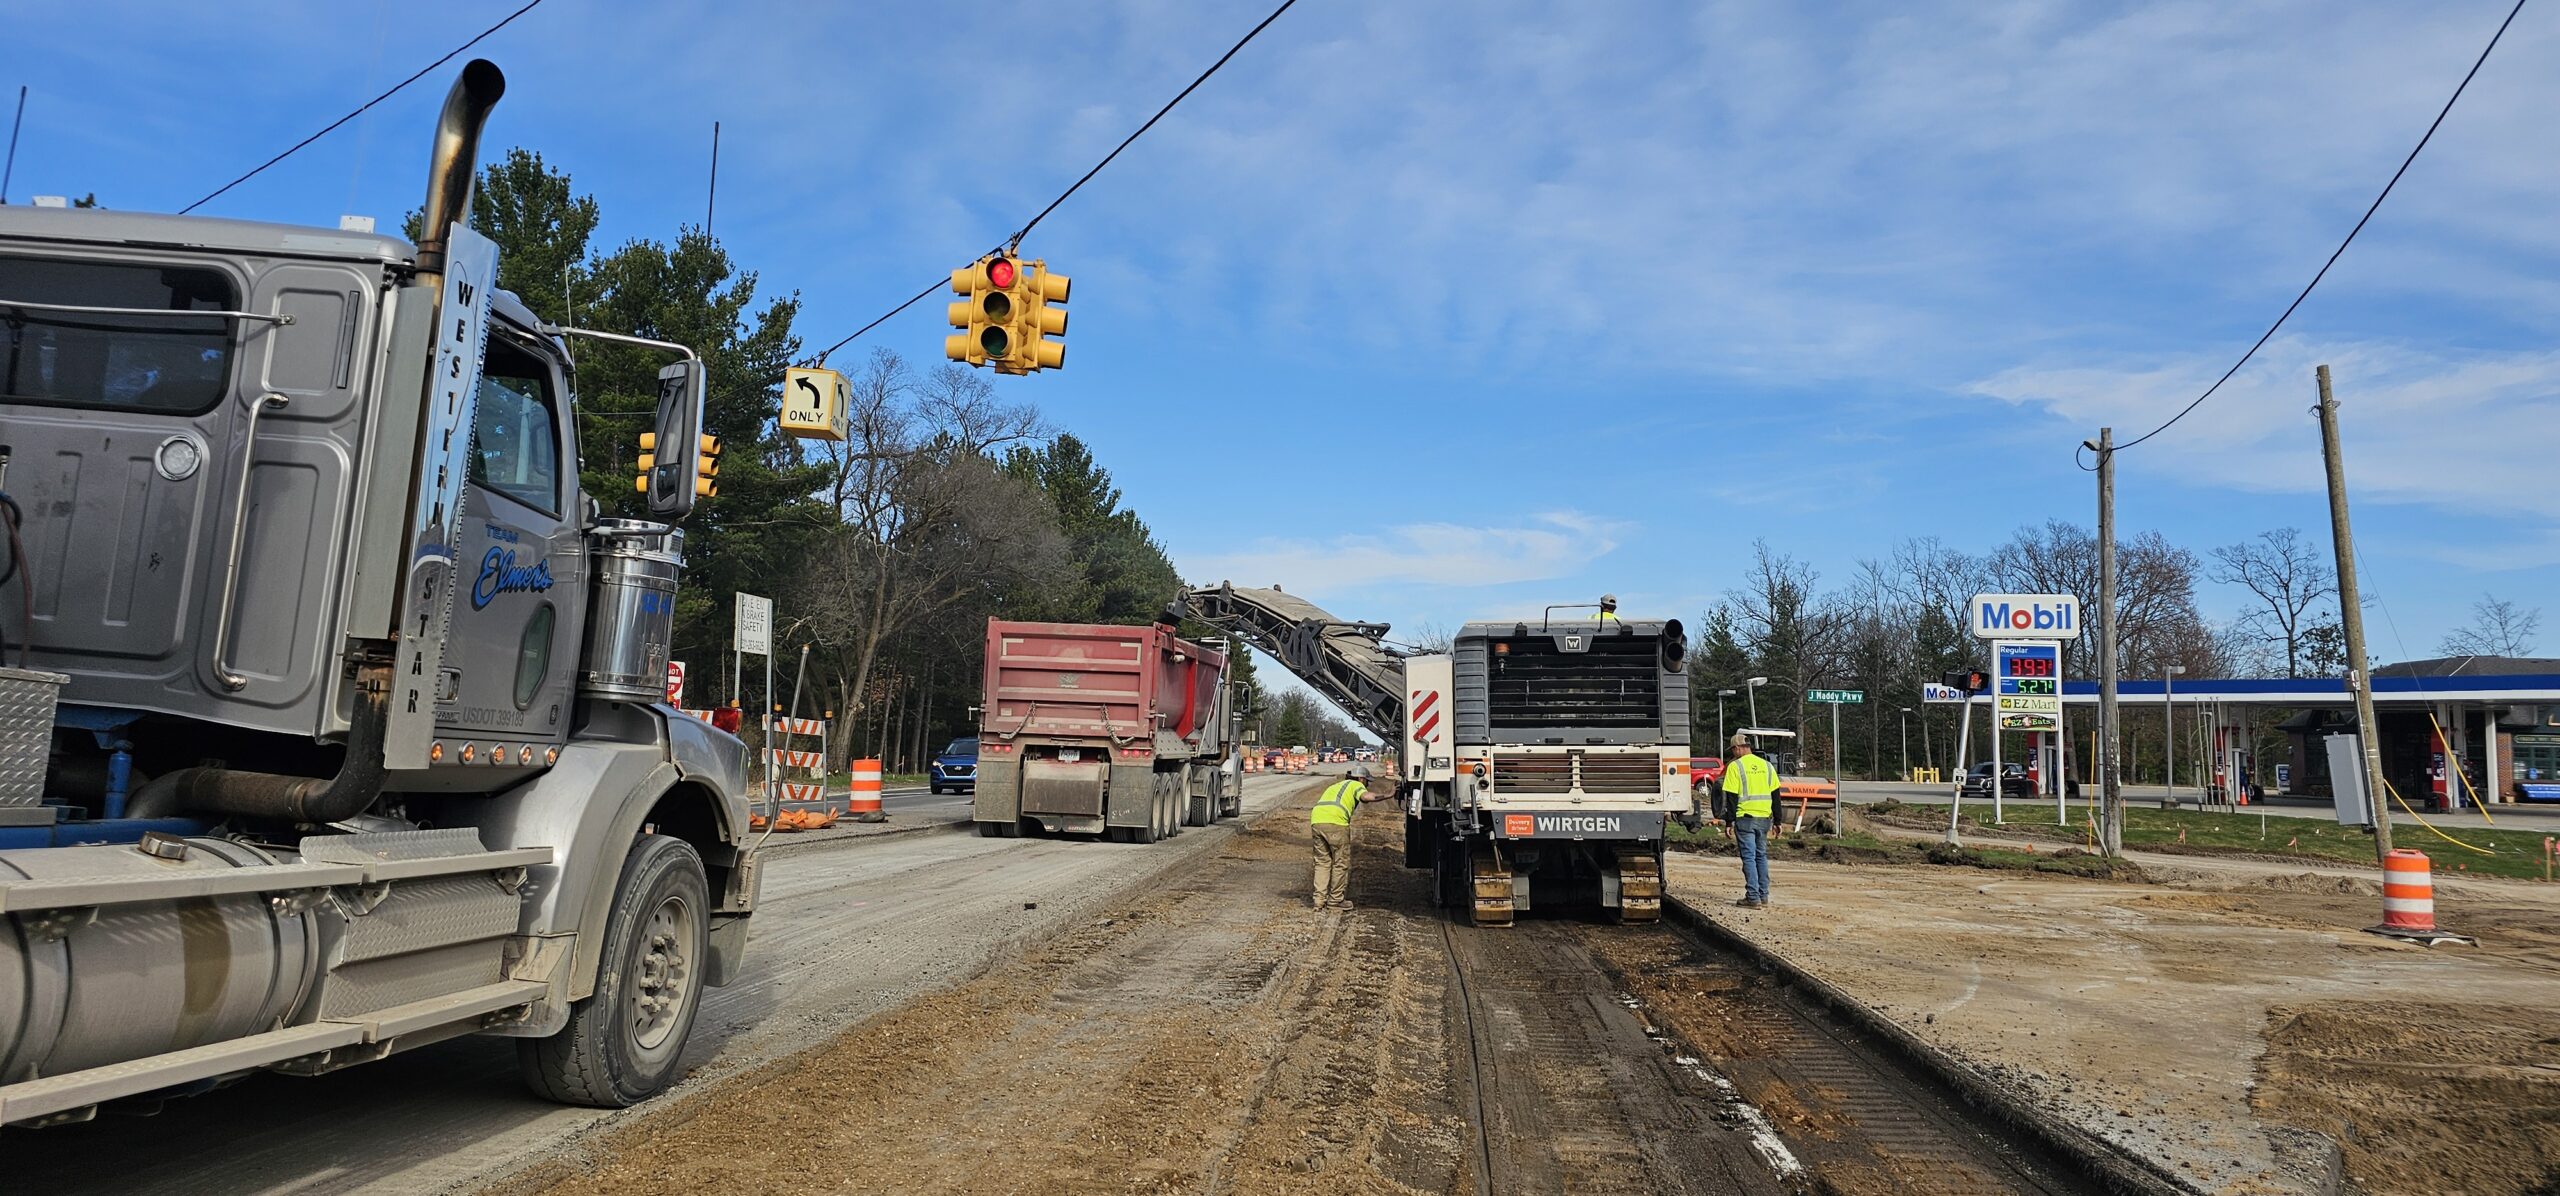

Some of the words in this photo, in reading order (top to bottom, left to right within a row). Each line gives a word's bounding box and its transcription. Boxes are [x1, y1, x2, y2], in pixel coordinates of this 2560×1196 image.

[789, 410, 824, 422] ONLY
[485, 523, 519, 544] TEAM
[471, 545, 554, 612] Elmer's
[747, 609, 765, 622] BRAKE
[1982, 603, 2071, 629] Mobil
[742, 619, 764, 633] SAFETY
[407, 577, 433, 713] STAR
[2000, 646, 2028, 655] Regular
[1808, 690, 1814, 700] J
[1816, 690, 1840, 702] Maddy
[1842, 691, 1863, 703] Pkwy
[2013, 699, 2029, 708] EZ
[2031, 699, 2056, 709] Mart
[463, 706, 497, 724] USDOT
[496, 709, 525, 727] 399189
[1537, 817, 1621, 832] WIRTGEN
